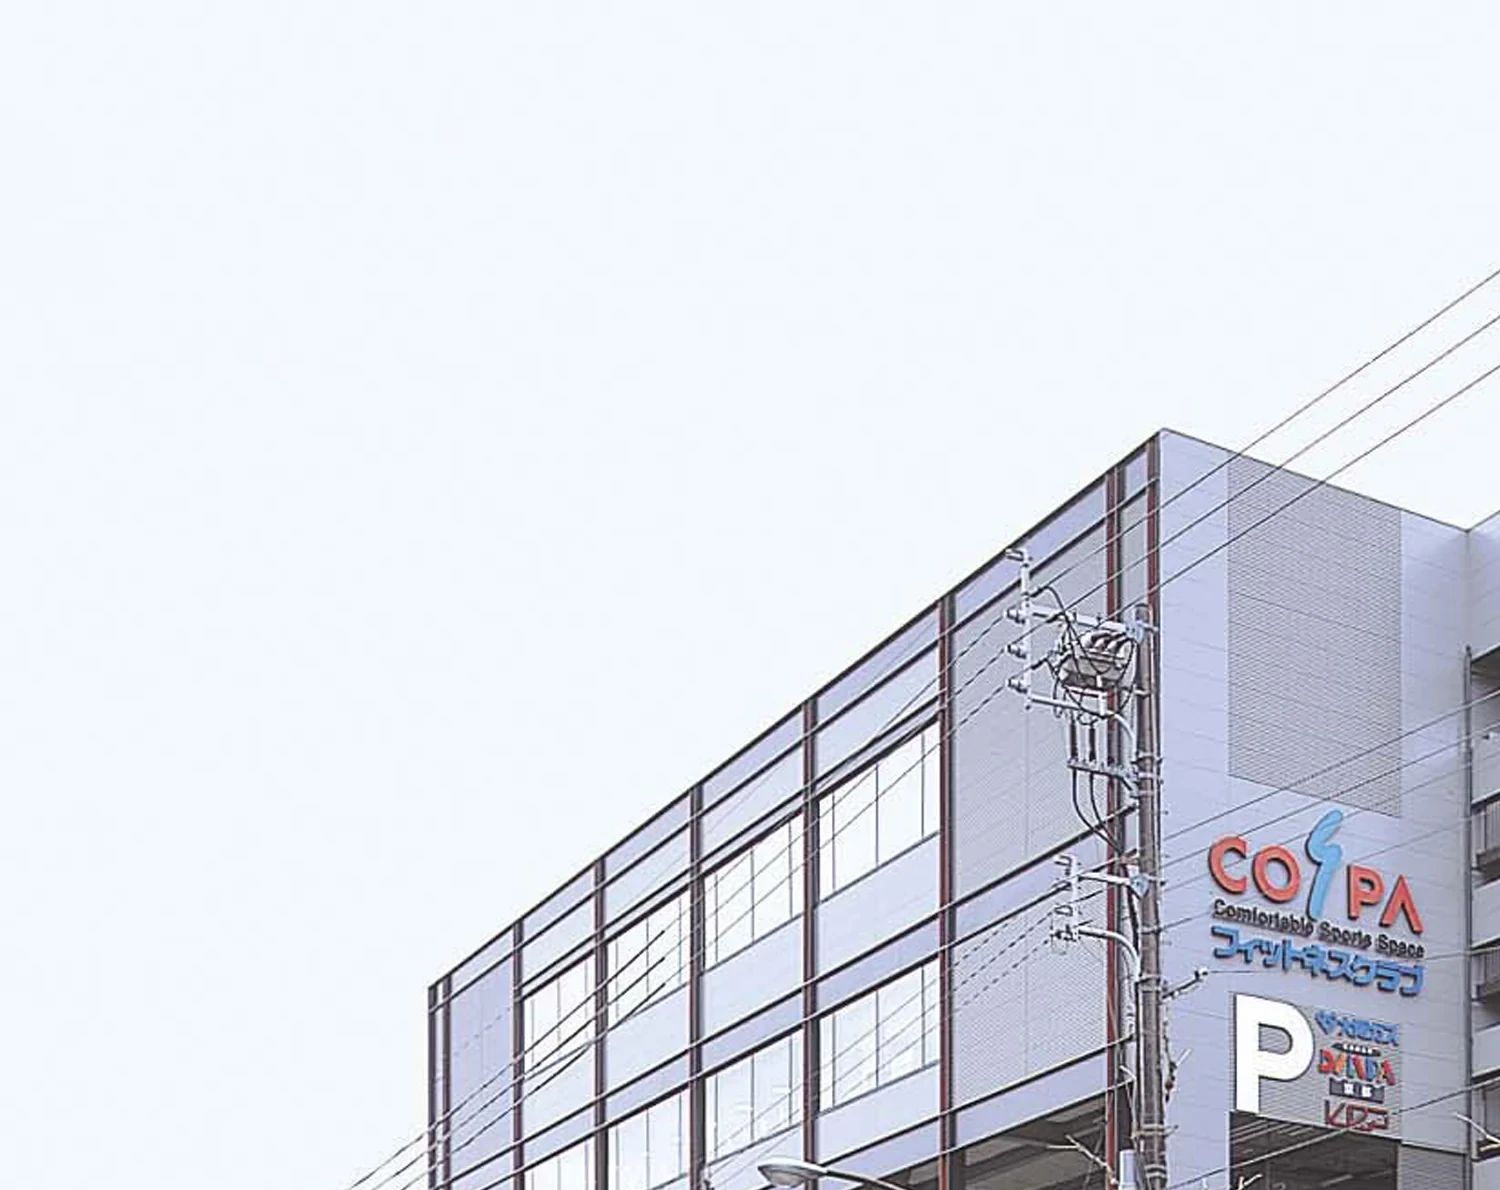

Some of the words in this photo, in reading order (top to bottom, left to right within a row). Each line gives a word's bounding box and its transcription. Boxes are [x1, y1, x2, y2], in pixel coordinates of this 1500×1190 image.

[1208, 809, 1424, 935] COSPA
[1212, 899, 1315, 938] Comfortable
[1317, 920, 1373, 948] Sports
[1377, 933, 1425, 960] Space
[1233, 991, 1316, 1114] P
